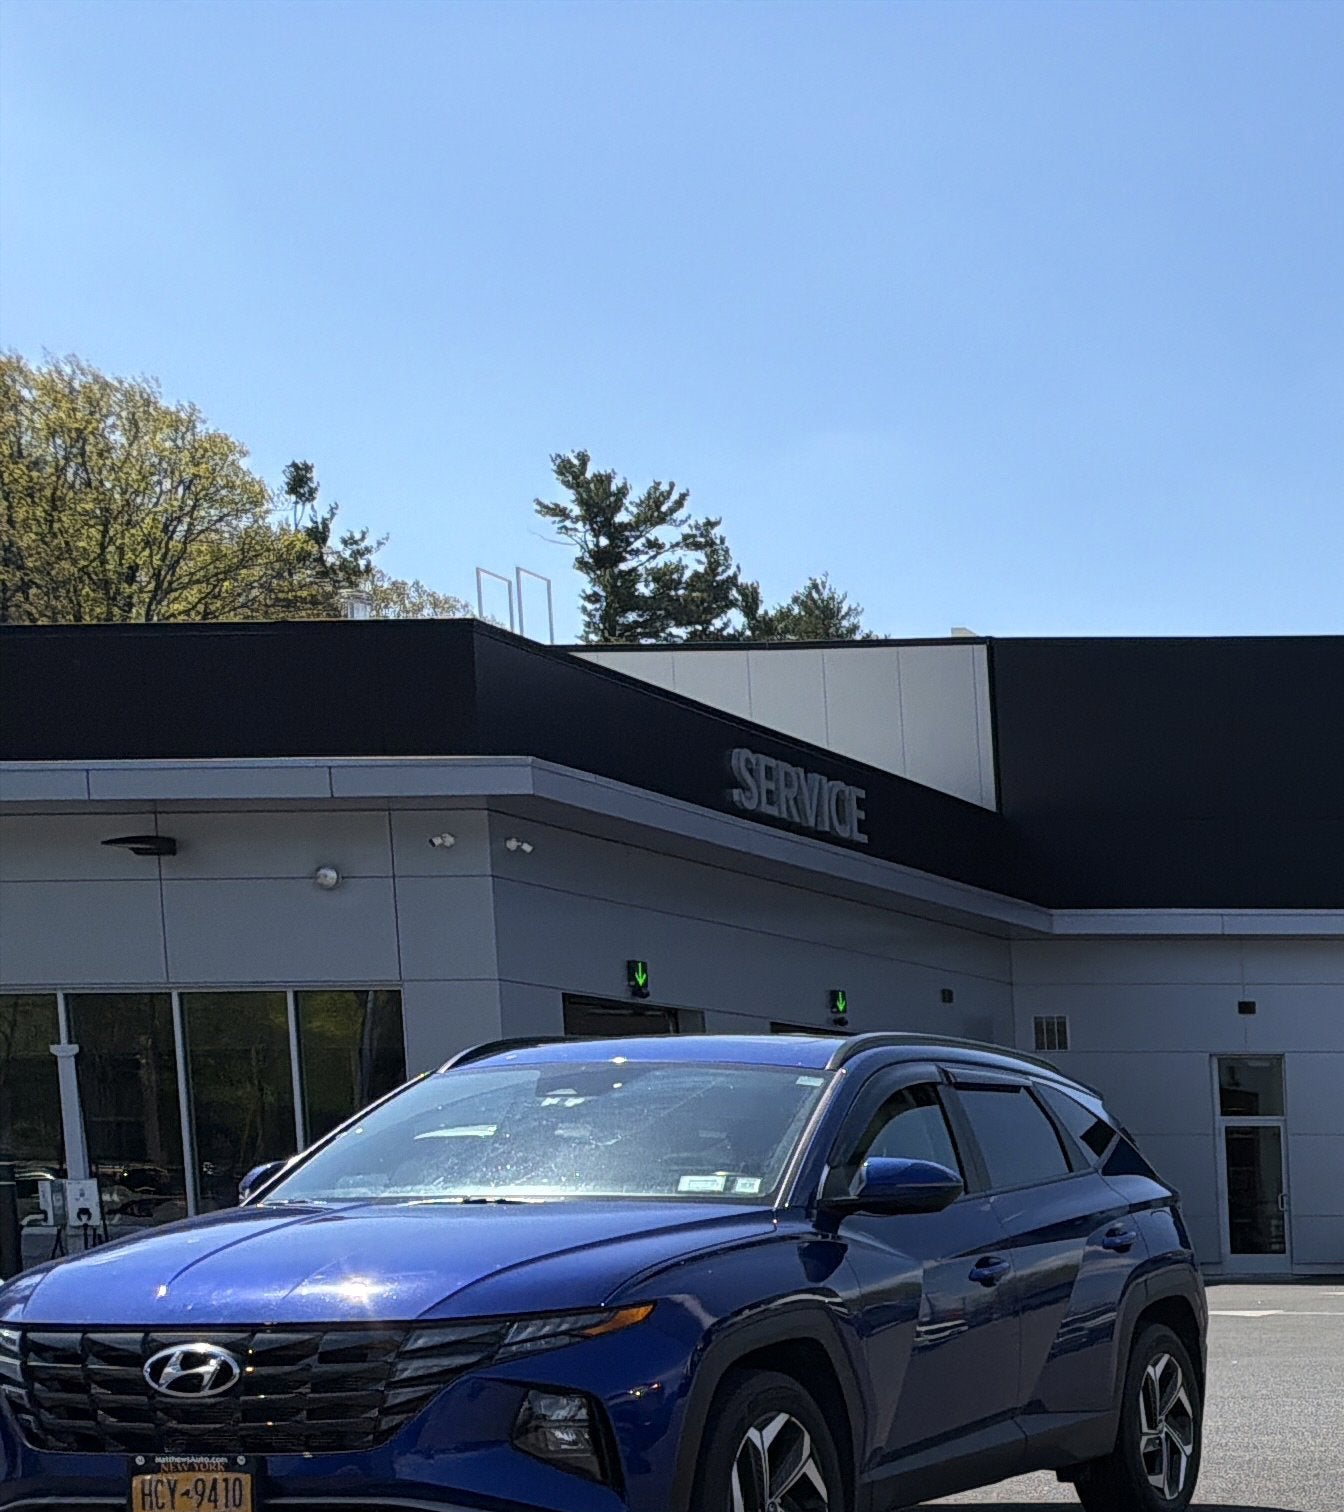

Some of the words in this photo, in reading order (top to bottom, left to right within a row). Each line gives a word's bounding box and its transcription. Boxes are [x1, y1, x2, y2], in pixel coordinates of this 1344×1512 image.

[731, 747, 868, 843] SERVICE
[160, 1462, 191, 1472] NEW
[194, 1462, 225, 1472] YORK
